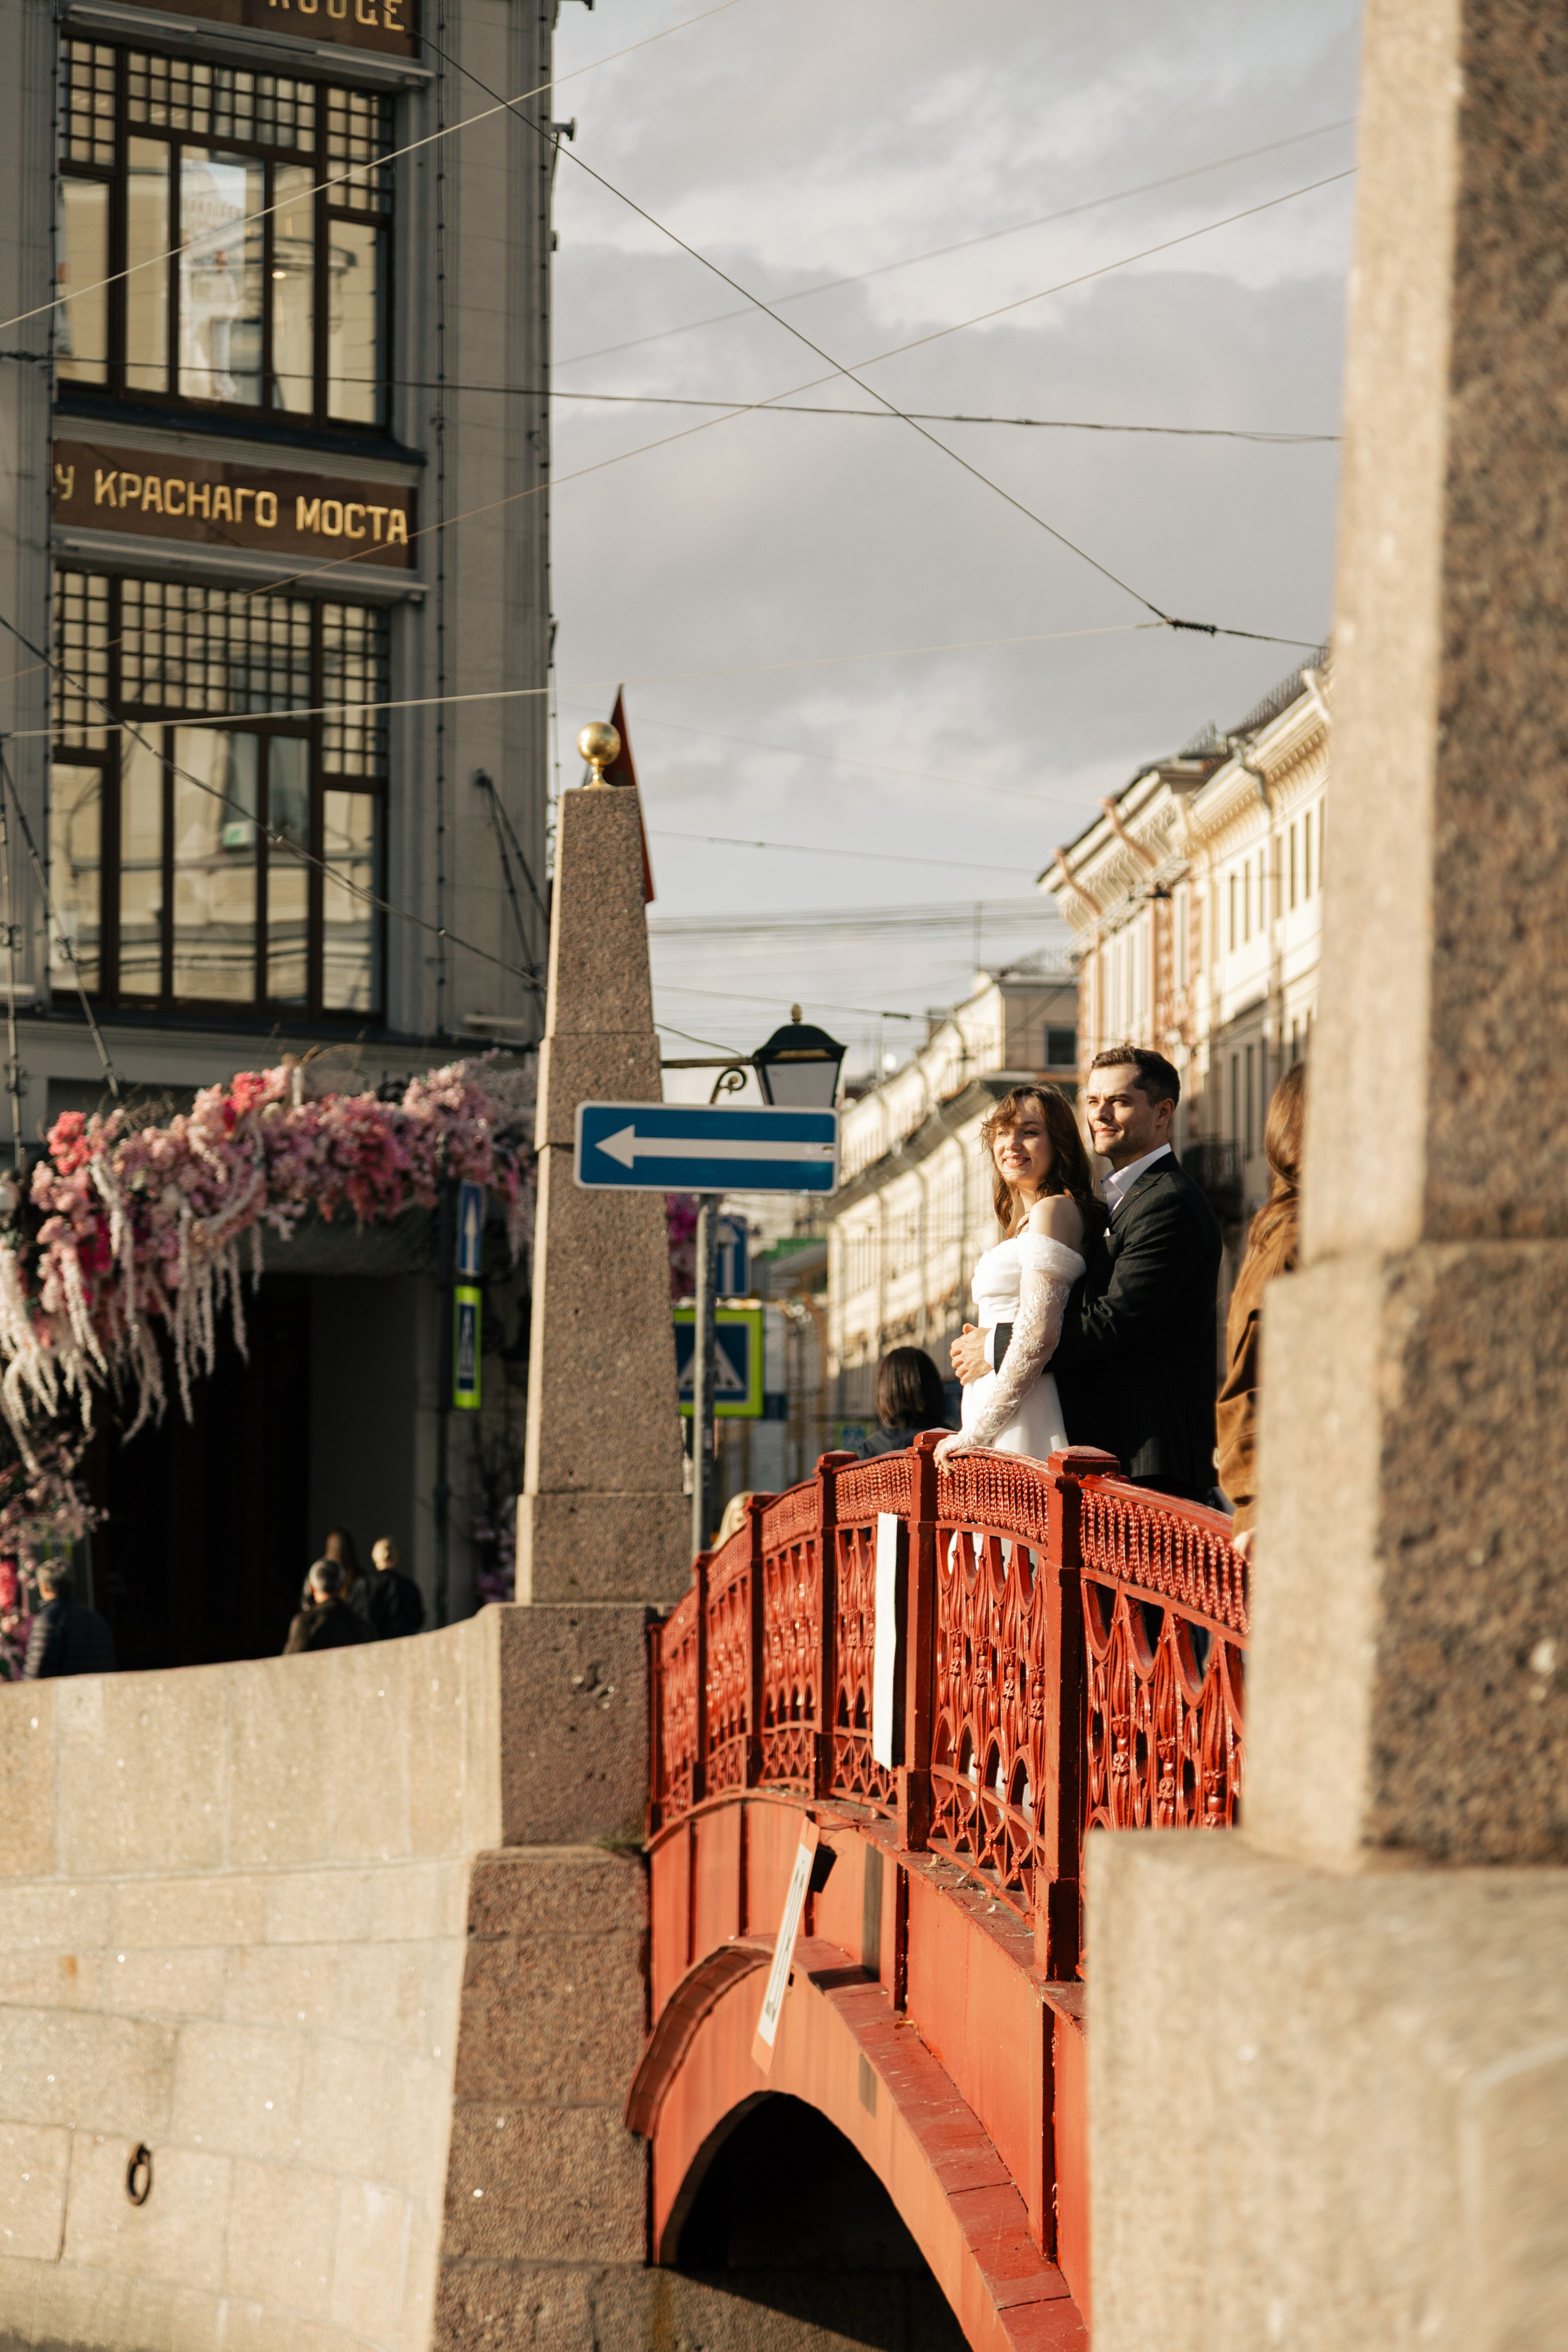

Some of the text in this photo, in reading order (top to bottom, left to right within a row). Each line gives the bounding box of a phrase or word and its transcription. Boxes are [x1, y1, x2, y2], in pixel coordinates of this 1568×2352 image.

[269, 0, 404, 31] UGE
[54, 463, 409, 546] У КРАСНАГО МОСТА
